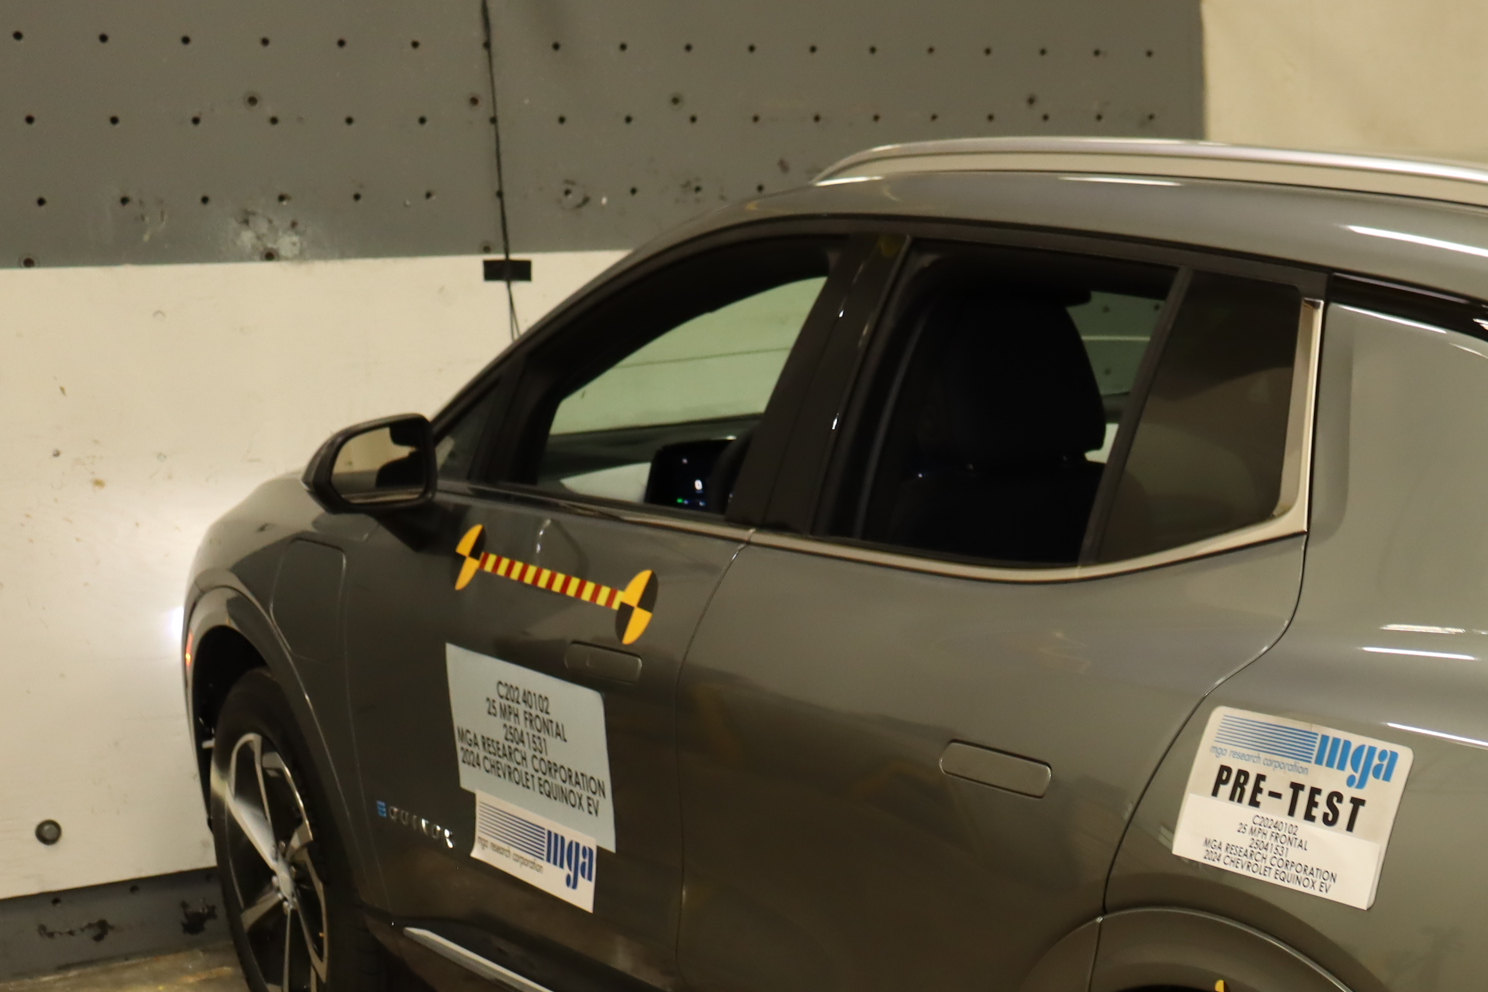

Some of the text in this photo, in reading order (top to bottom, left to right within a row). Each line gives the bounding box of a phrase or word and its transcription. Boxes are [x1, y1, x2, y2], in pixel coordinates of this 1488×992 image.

[486, 698, 567, 743] 25 MPH FRONTAL
[458, 726, 605, 799] MGA RESEARCH CORPORATION
[461, 747, 599, 817] 2024 CHEVROLET EQUINOX EV
[1210, 745, 1309, 775] mga research corporation
[1314, 734, 1398, 790] mga
[1211, 765, 1366, 832] PRE-TEST
[1237, 822, 1307, 851] 25 MPH FRONTAL
[1249, 838, 1289, 856] 25041531
[1252, 815, 1298, 836] C20240102
[490, 841, 511, 859] research
[513, 852, 543, 874] corporation
[546, 829, 593, 890] mga
[1204, 837, 1337, 883] MGA RESEARCH CORPORATION
[1204, 849, 1331, 894] 2024 CHEVROLET EQUINOX EV
